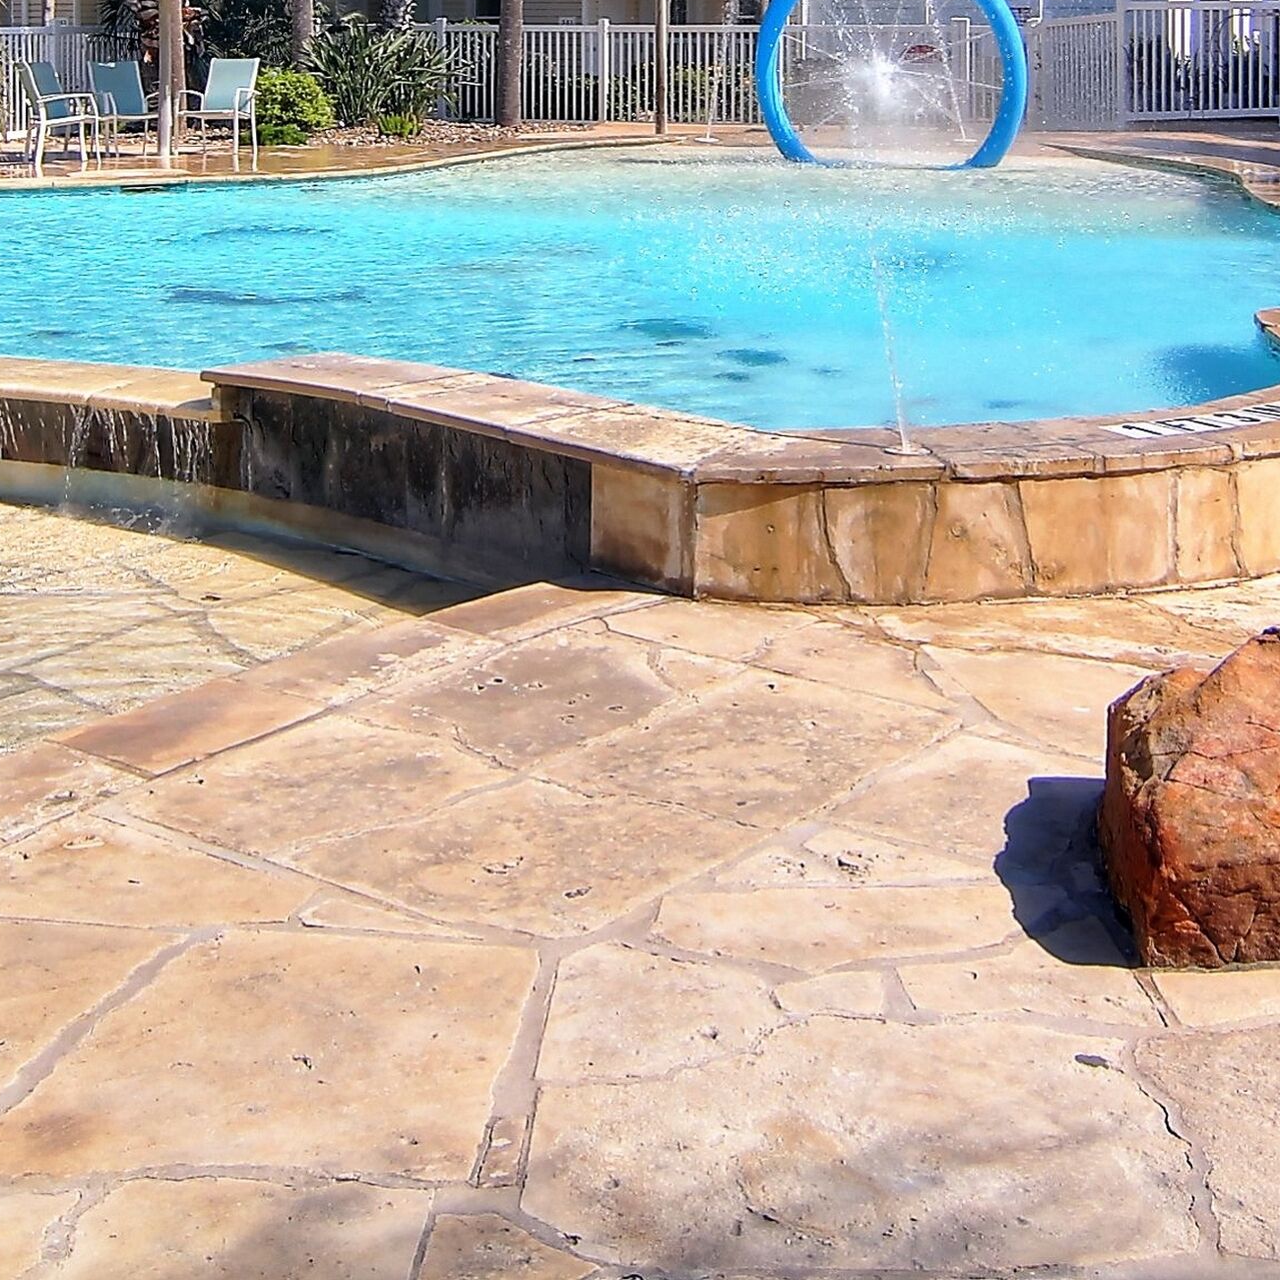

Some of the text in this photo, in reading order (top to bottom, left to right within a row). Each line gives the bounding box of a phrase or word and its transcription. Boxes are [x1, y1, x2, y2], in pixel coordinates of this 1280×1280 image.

[1122, 424, 1163, 435] 1
[1156, 417, 1222, 432] FT
[1213, 413, 1261, 422] 3
